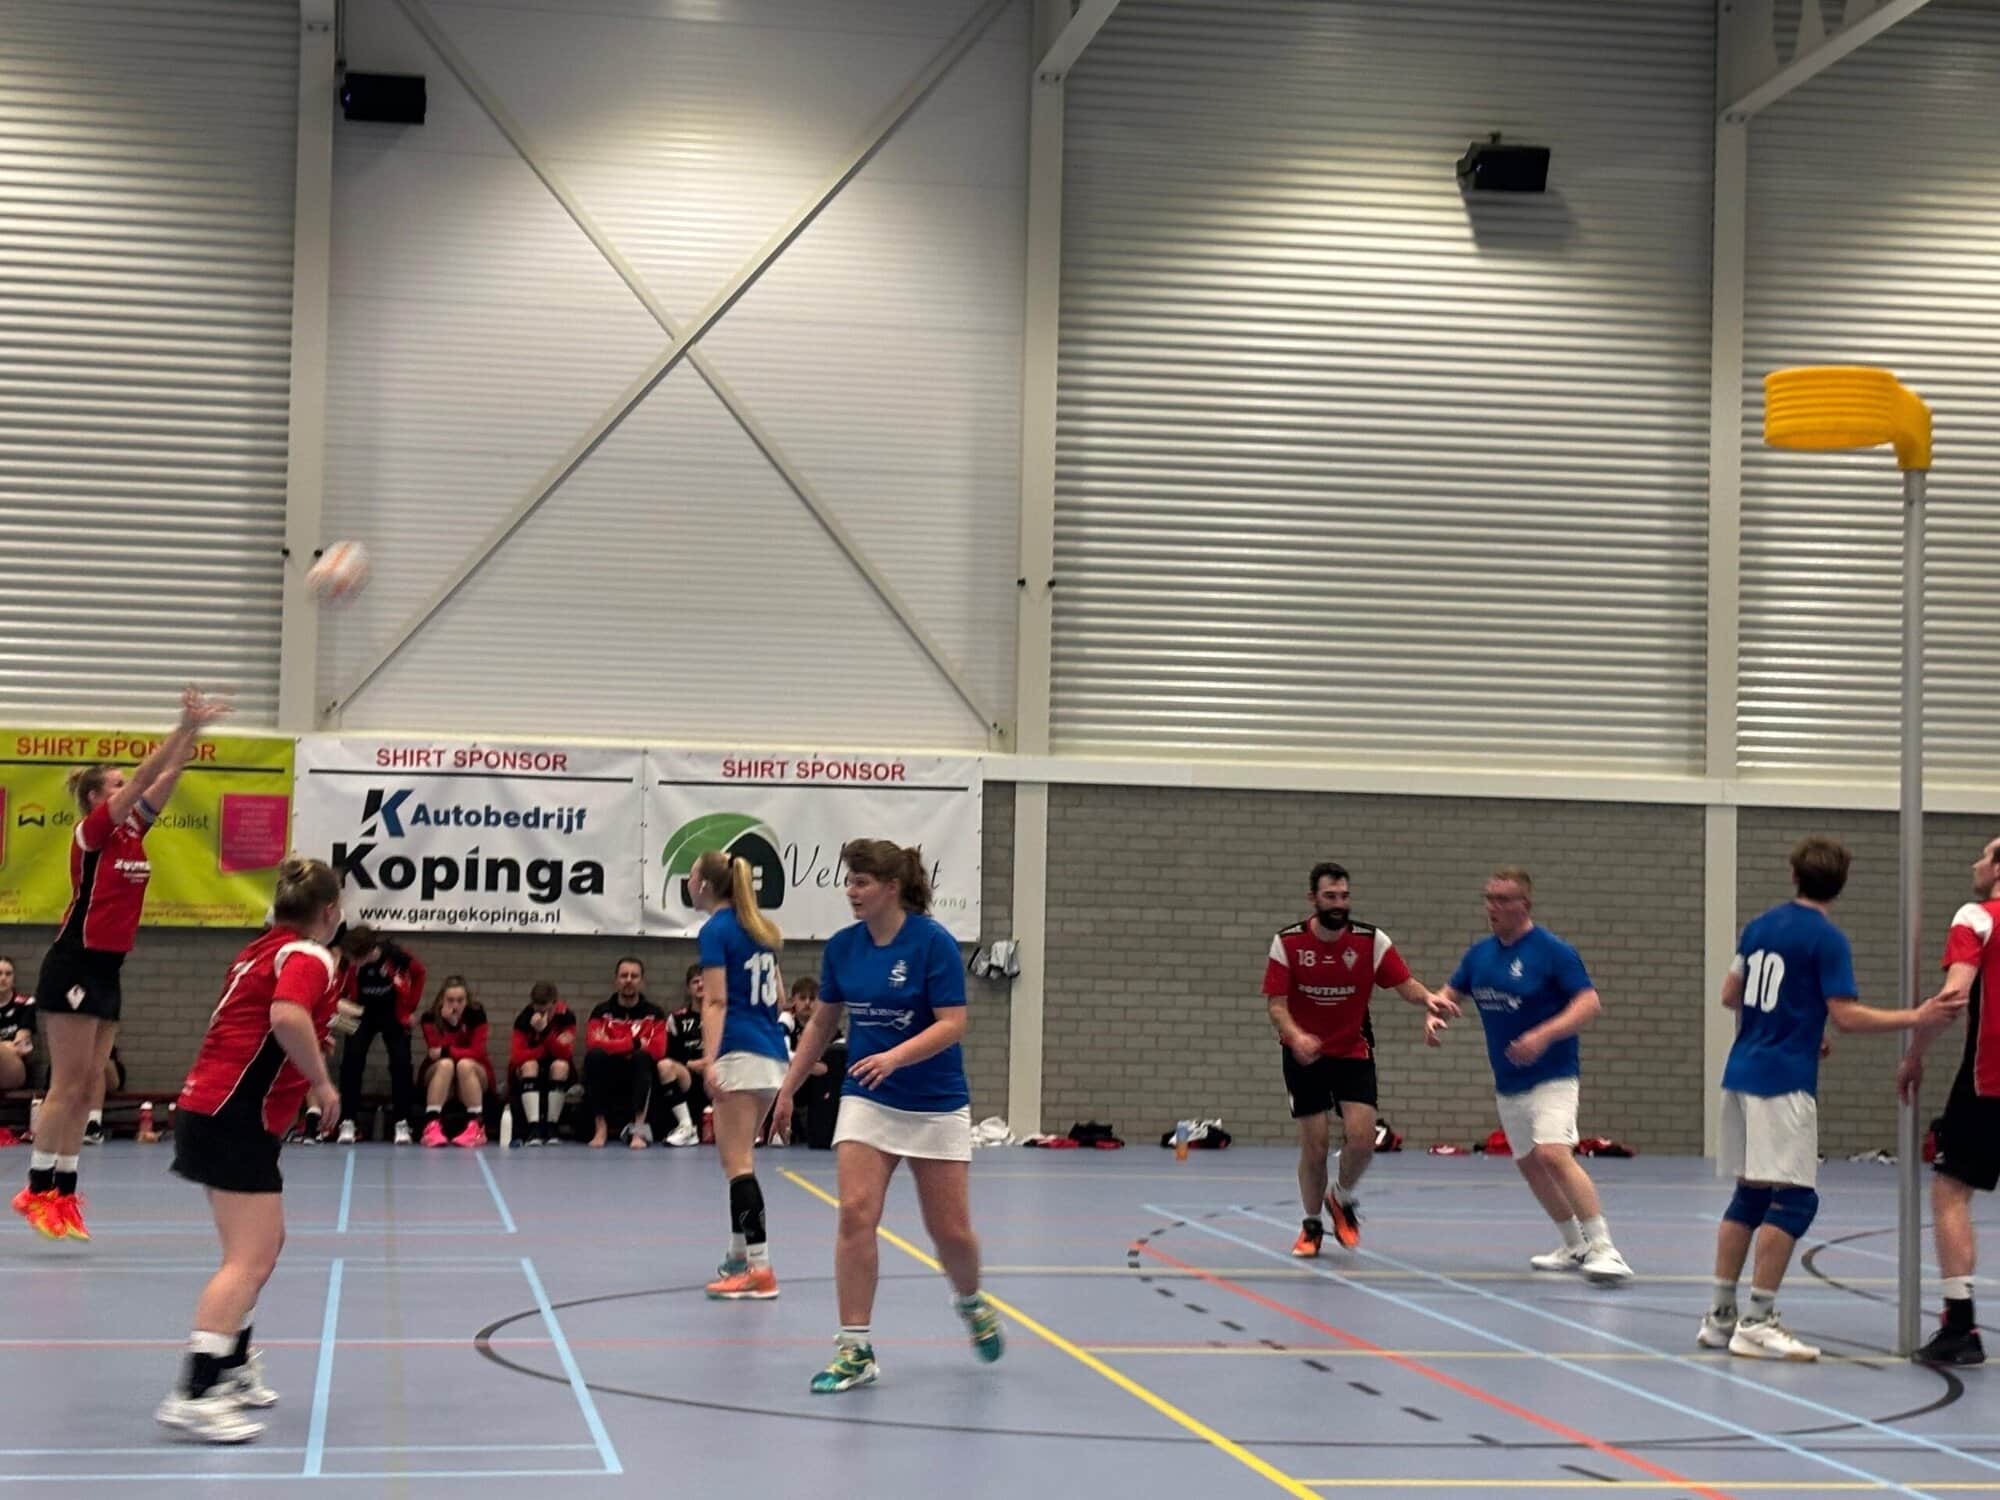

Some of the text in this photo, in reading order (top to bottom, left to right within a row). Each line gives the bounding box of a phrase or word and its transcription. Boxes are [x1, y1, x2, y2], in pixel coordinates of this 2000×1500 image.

[16, 735, 217, 761] SHIRT SPONOR
[376, 747, 568, 772] SHIRT SPONSOR
[721, 759, 906, 782] SHIRT SPONSOR
[51, 810, 74, 826] de
[410, 803, 587, 834] Autobedrijf
[359, 906, 561, 925] www.garagekopinga.nl
[1296, 949, 1317, 967] 18
[744, 952, 778, 1007] 13
[1743, 949, 1785, 1013] 10
[681, 1018, 694, 1032] 17
